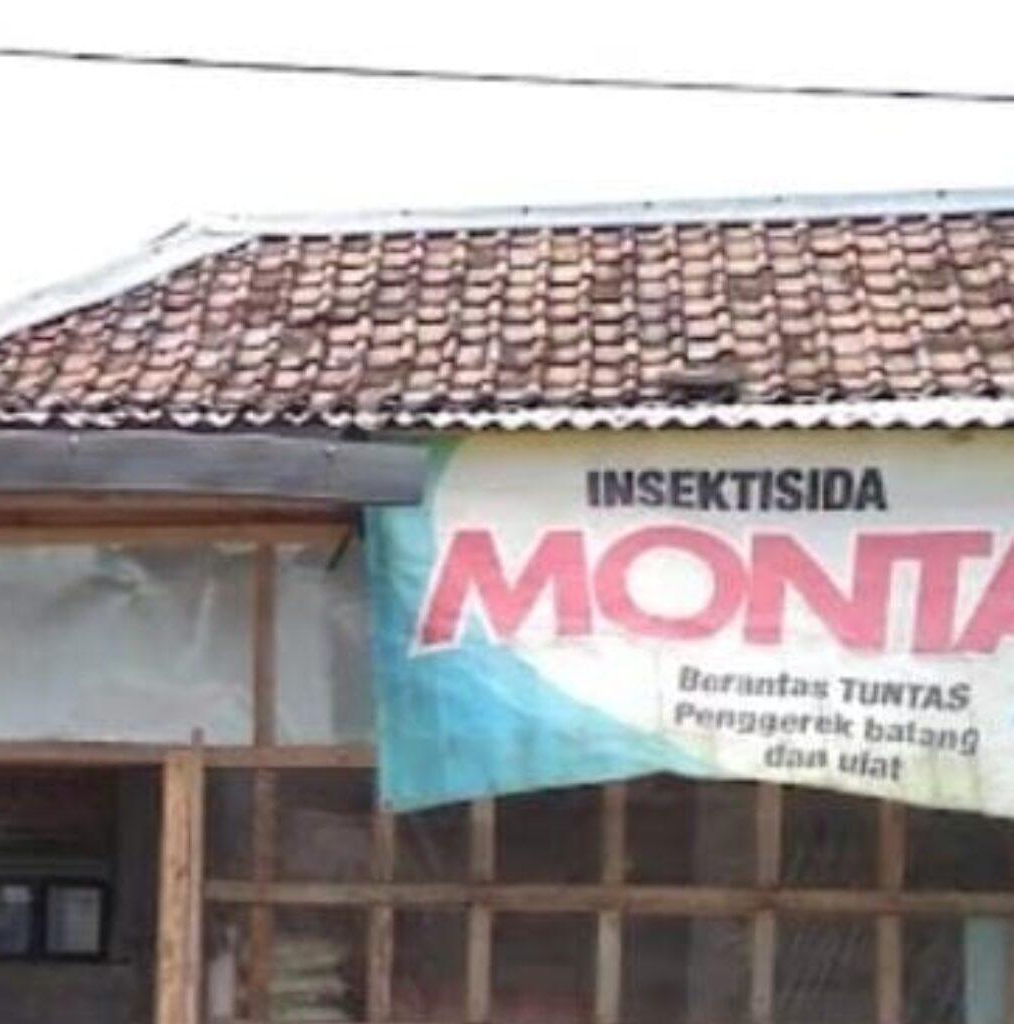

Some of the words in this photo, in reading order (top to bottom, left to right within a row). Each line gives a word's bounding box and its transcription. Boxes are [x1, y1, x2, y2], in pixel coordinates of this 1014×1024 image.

[586, 468, 888, 511] INSEKTISIDA
[678, 664, 829, 698] Berantas
[838, 677, 971, 712] TUNTAS
[673, 701, 854, 735] Penggerek
[864, 716, 981, 757] batang
[763, 742, 828, 769] dan
[837, 750, 904, 781] ulat
